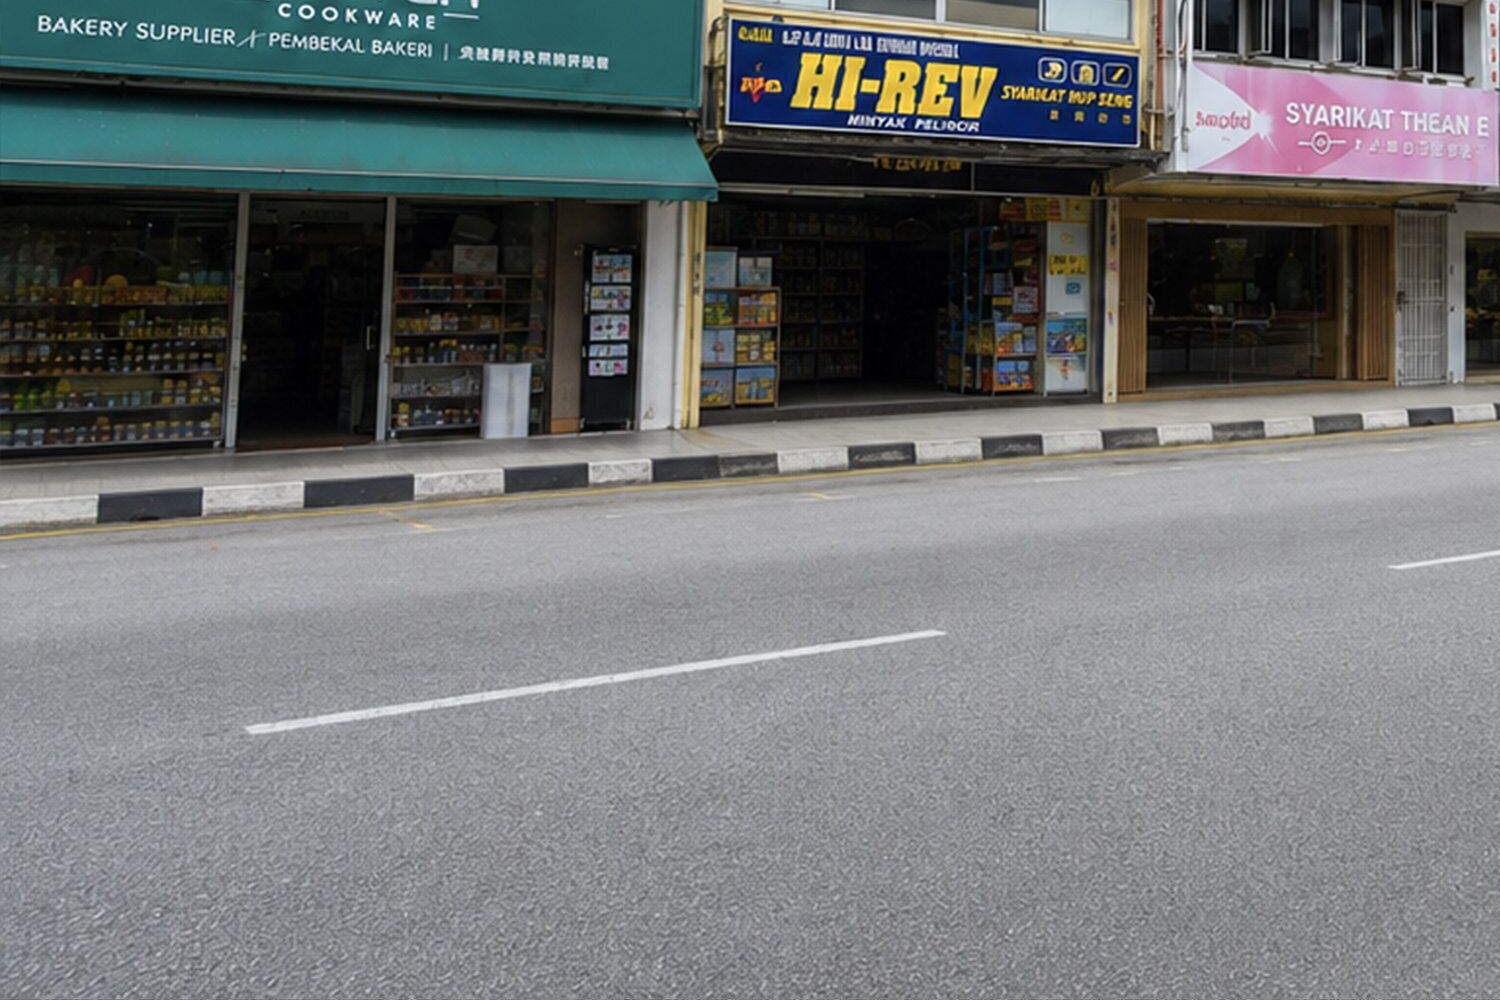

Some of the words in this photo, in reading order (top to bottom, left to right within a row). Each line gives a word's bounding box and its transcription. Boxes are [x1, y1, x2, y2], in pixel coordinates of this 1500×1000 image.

[277, 3, 436, 29] COOKWARE
[37, 15, 128, 38] BAKERY
[136, 22, 236, 45] SUPPLIER
[268, 32, 365, 54] PEMBEKAL
[371, 40, 433, 58] BAKERI
[789, 52, 998, 118] HI-REV
[1286, 102, 1394, 129] SYARIKAT
[1401, 110, 1469, 135] THEAN
[1477, 116, 1489, 136] E
